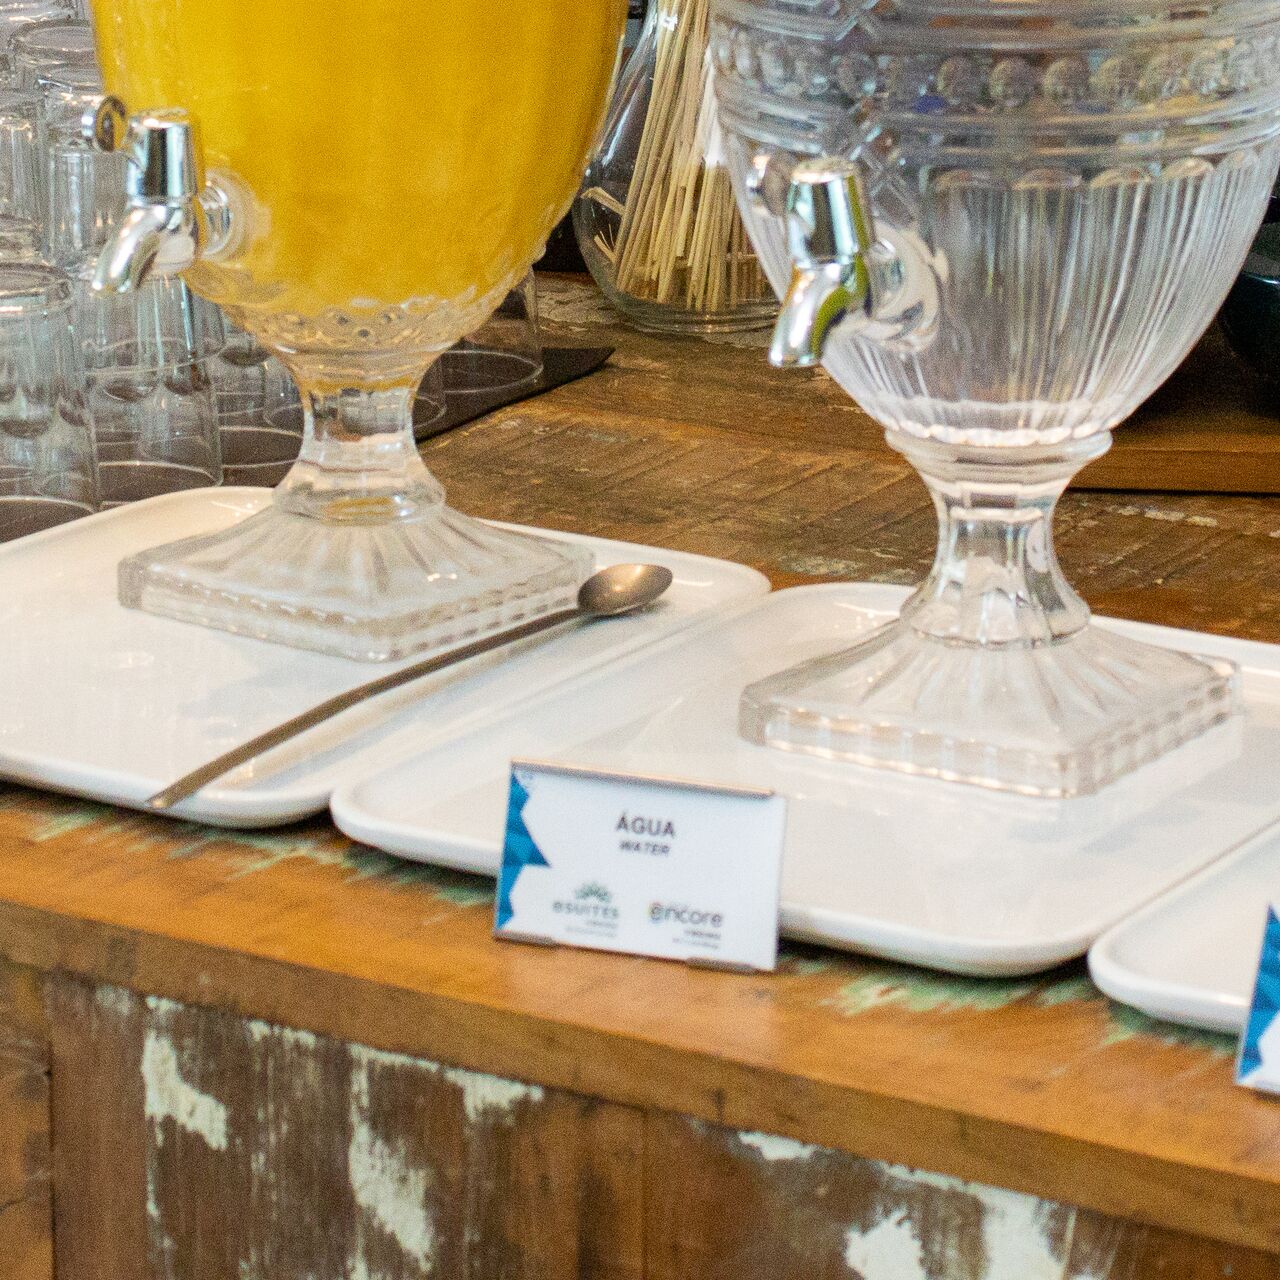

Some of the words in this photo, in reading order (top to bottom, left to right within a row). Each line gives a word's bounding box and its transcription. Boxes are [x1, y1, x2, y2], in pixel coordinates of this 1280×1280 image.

[615, 809, 676, 839] ÁGUA
[619, 840, 671, 857] WATER
[649, 901, 724, 928] encore
